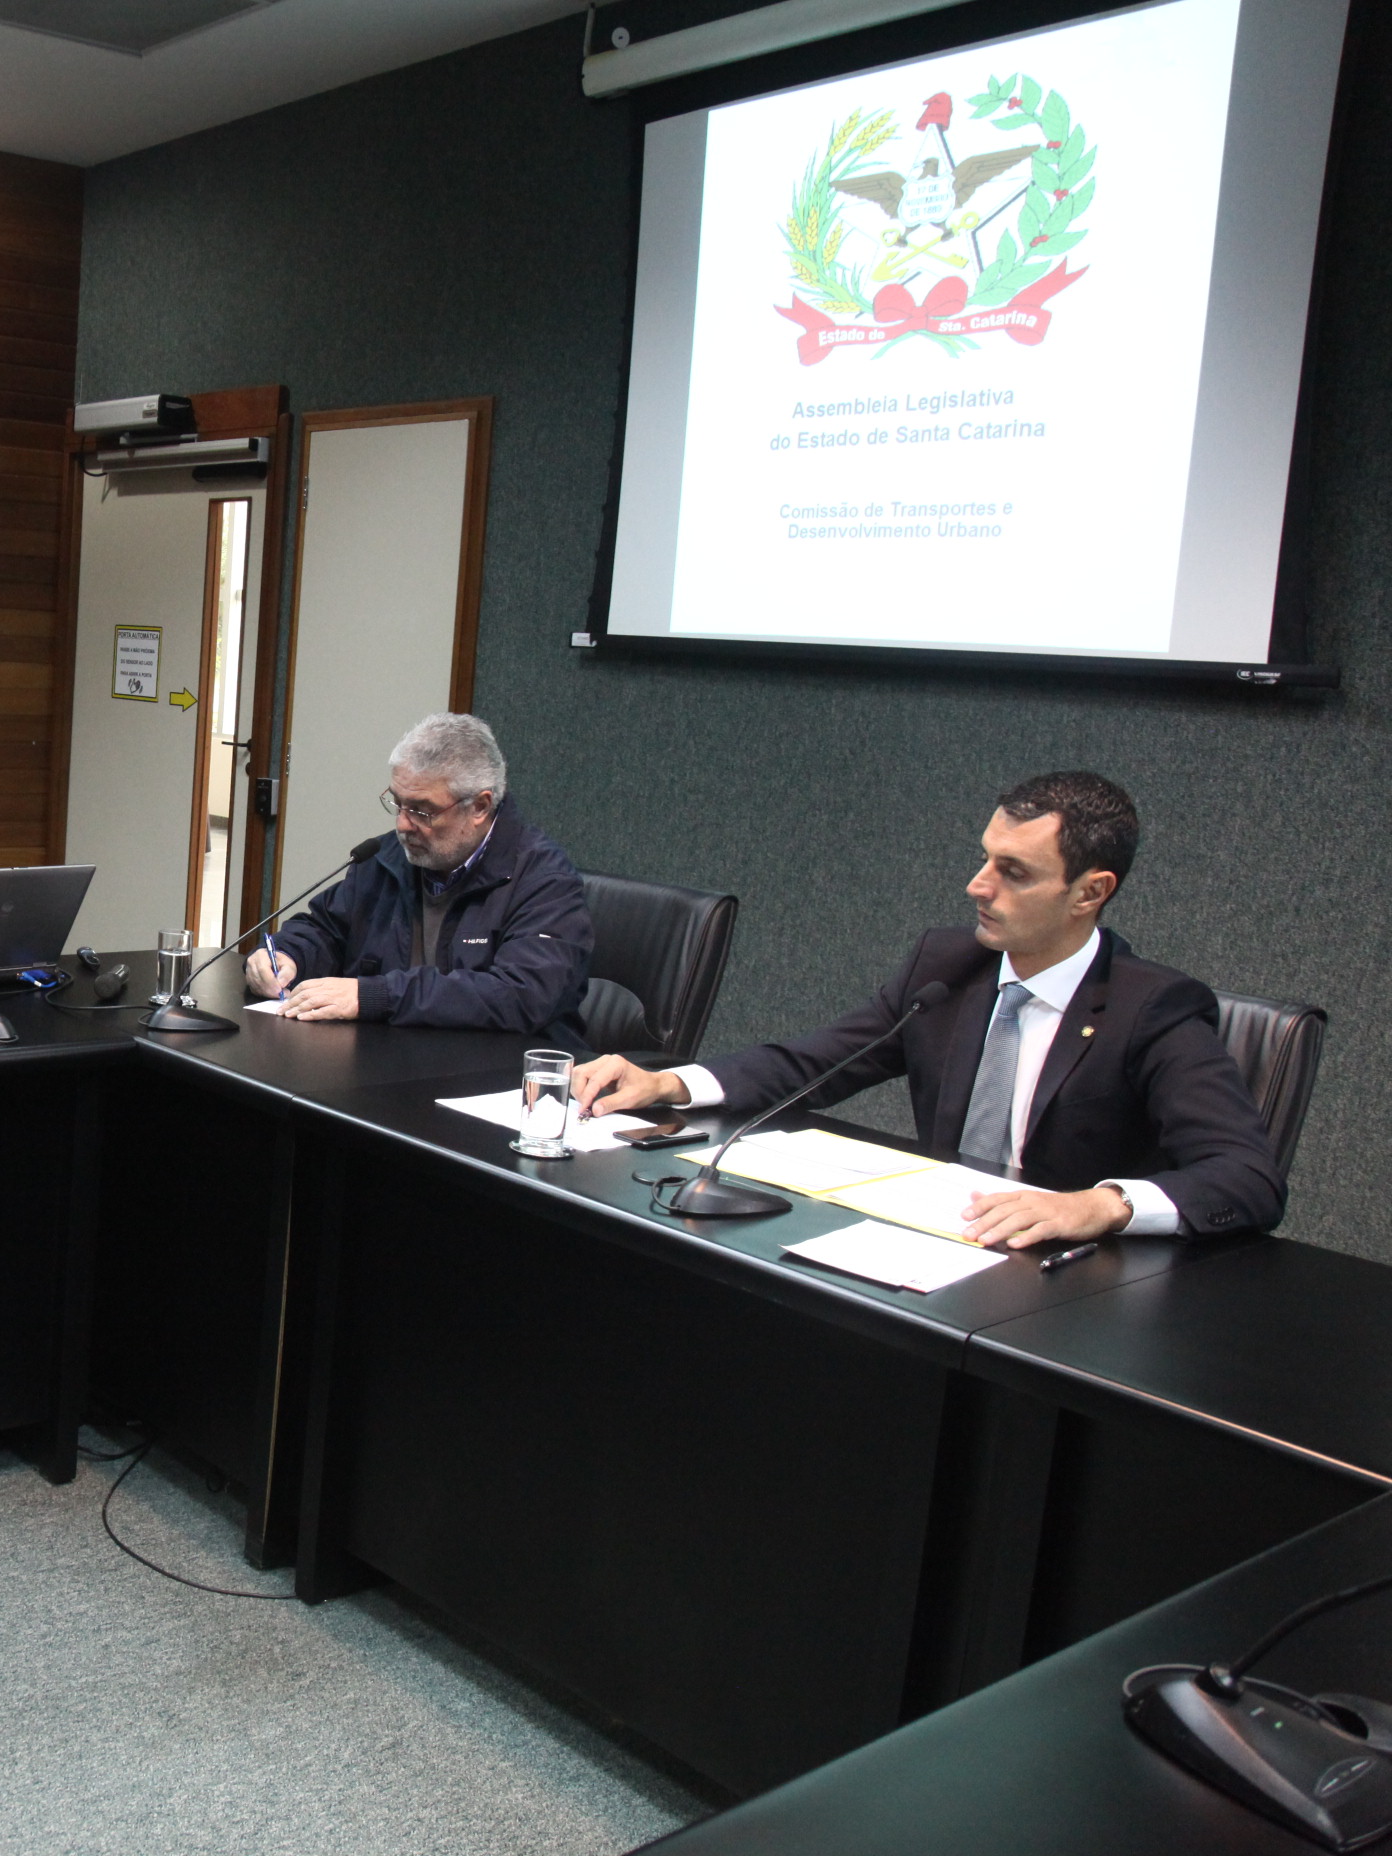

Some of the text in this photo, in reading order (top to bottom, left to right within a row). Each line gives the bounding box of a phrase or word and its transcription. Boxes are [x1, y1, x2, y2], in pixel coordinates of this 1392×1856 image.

[938, 310, 1037, 332] Sta. Catarina
[818, 328, 885, 346] Estado de
[792, 389, 1015, 419] Assembleia Legislativa
[769, 419, 1046, 450] do Estado de Santa Catarina
[779, 501, 1013, 520] Comissão de Transportes e
[788, 521, 1002, 539] Desenvolvimento Urbano
[118, 631, 159, 640] PORTA AUTOMÁTICA
